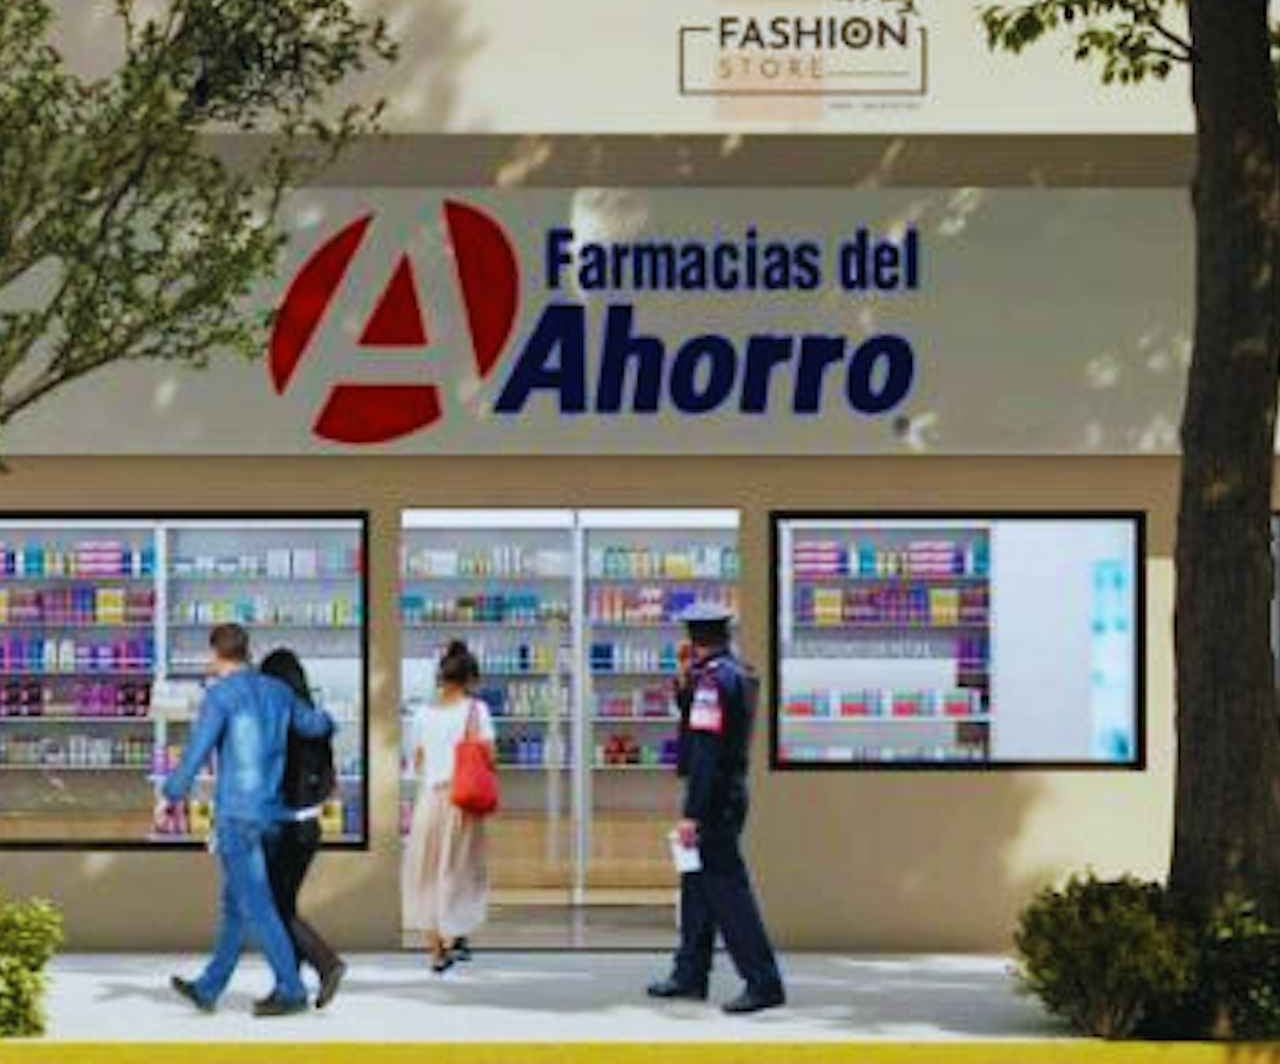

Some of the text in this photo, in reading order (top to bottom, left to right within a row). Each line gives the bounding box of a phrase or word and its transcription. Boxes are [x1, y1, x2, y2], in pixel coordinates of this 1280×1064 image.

[719, 16, 908, 50] FASHION
[718, 56, 824, 79] STORE
[545, 228, 919, 292] Farmacias del
[492, 303, 915, 415] Ahorro
